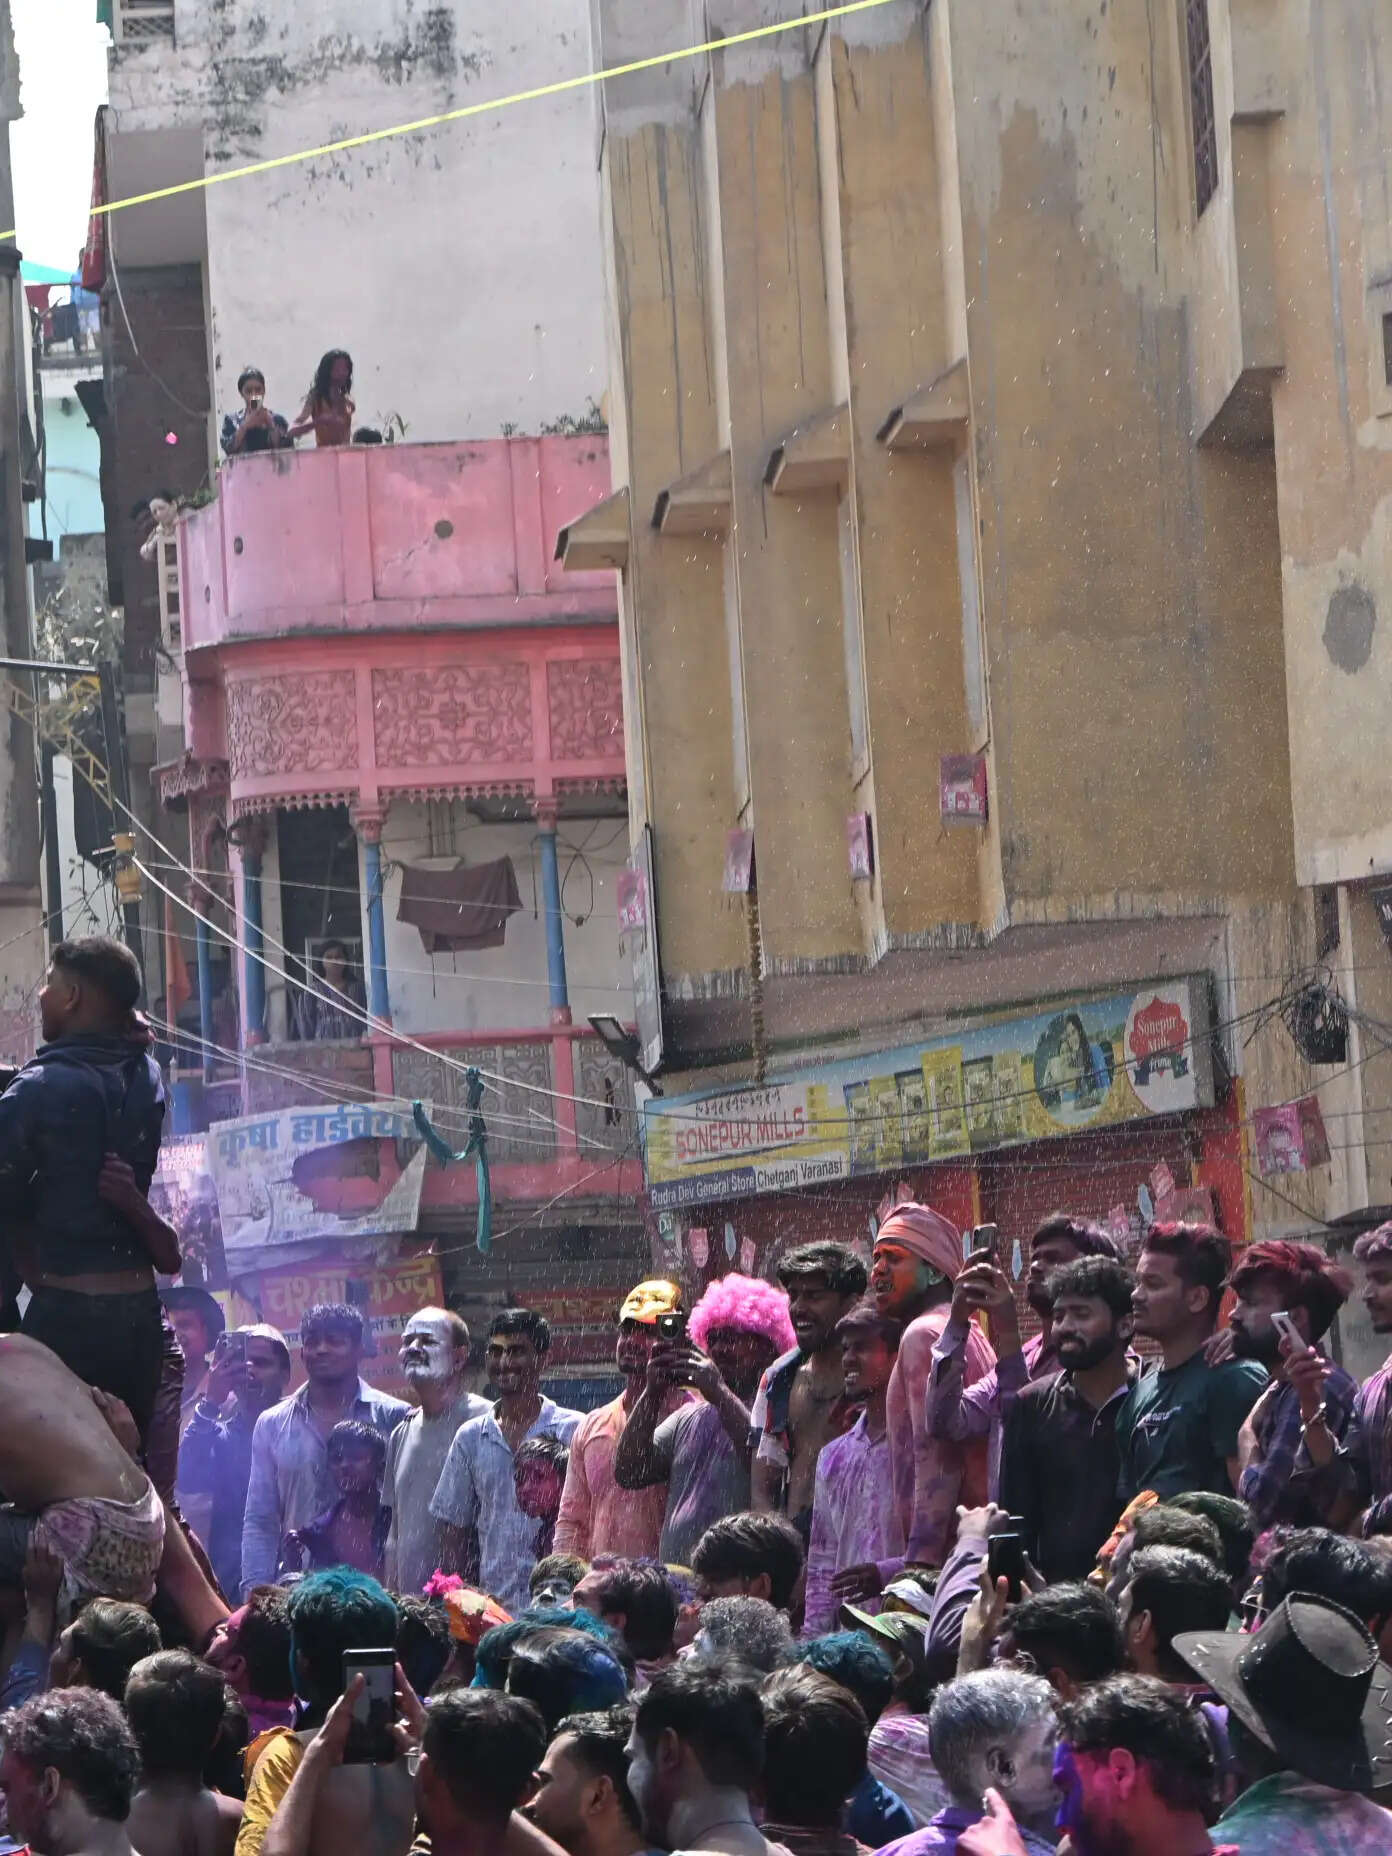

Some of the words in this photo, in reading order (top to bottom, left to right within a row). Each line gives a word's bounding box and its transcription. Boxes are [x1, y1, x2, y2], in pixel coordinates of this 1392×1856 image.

[675, 1116, 753, 1159] SONEPUR
[758, 1107, 805, 1143] MILLS
[651, 1187, 677, 1206] Rudra
[696, 1173, 730, 1198] General
[731, 1173, 755, 1192] Store
[757, 1165, 799, 1190] Chetganj
[800, 1156, 843, 1179] Varanasi
